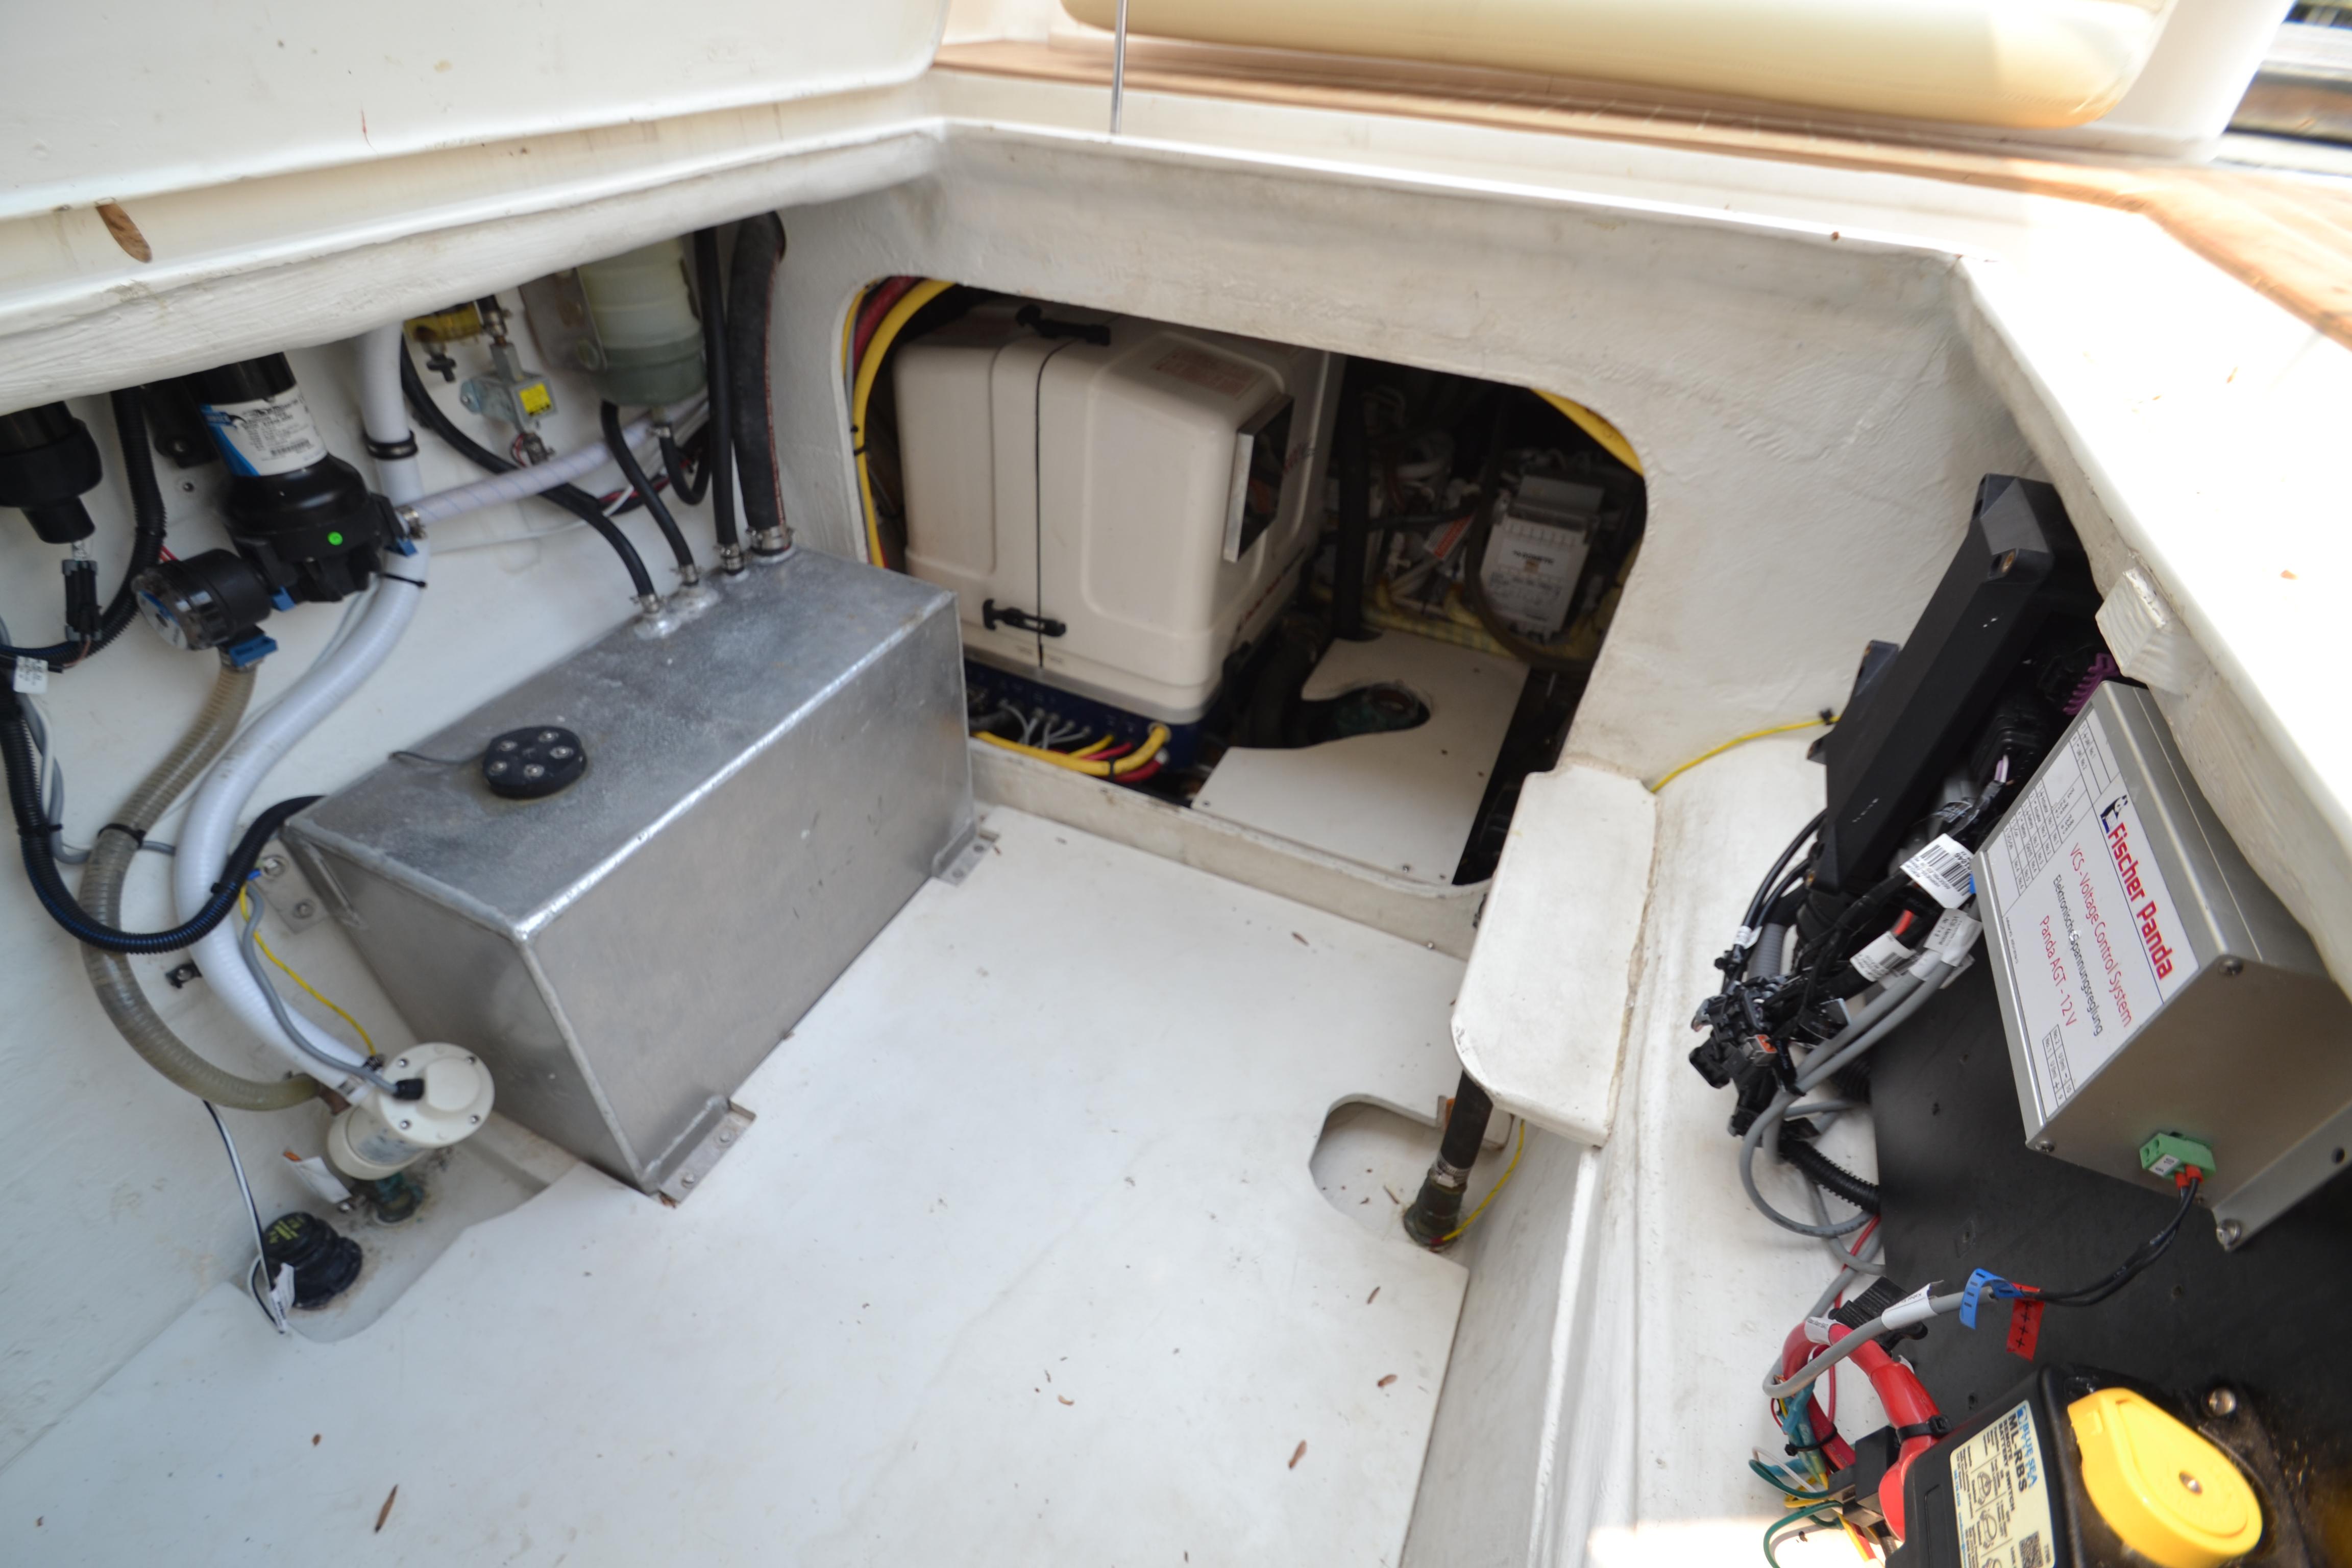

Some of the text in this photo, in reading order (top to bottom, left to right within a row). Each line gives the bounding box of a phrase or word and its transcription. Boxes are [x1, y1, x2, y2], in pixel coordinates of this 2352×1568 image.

[2108, 823, 2172, 979] Fischer Panda
[2040, 915, 2056, 959] Panda
[2070, 842, 2085, 871] VCS
[2079, 872, 2099, 924] Voltage
[2094, 921, 2118, 974] Control
[2109, 970, 2132, 1026] System
[2049, 957, 2066, 986] AGT
[2069, 934, 2102, 1036] Spannungsreglung
[2060, 994, 2072, 1016] 12
[2065, 1011, 2077, 1026] V
[2066, 1084, 2072, 1093] 10
[2002, 1418, 2012, 1459] REMOTE
[2007, 1412, 2027, 1491] ML-RBS
[2022, 1422, 2037, 1485] BLUE SEA
[1998, 1422, 2014, 1511] BATTERY SWITCH
